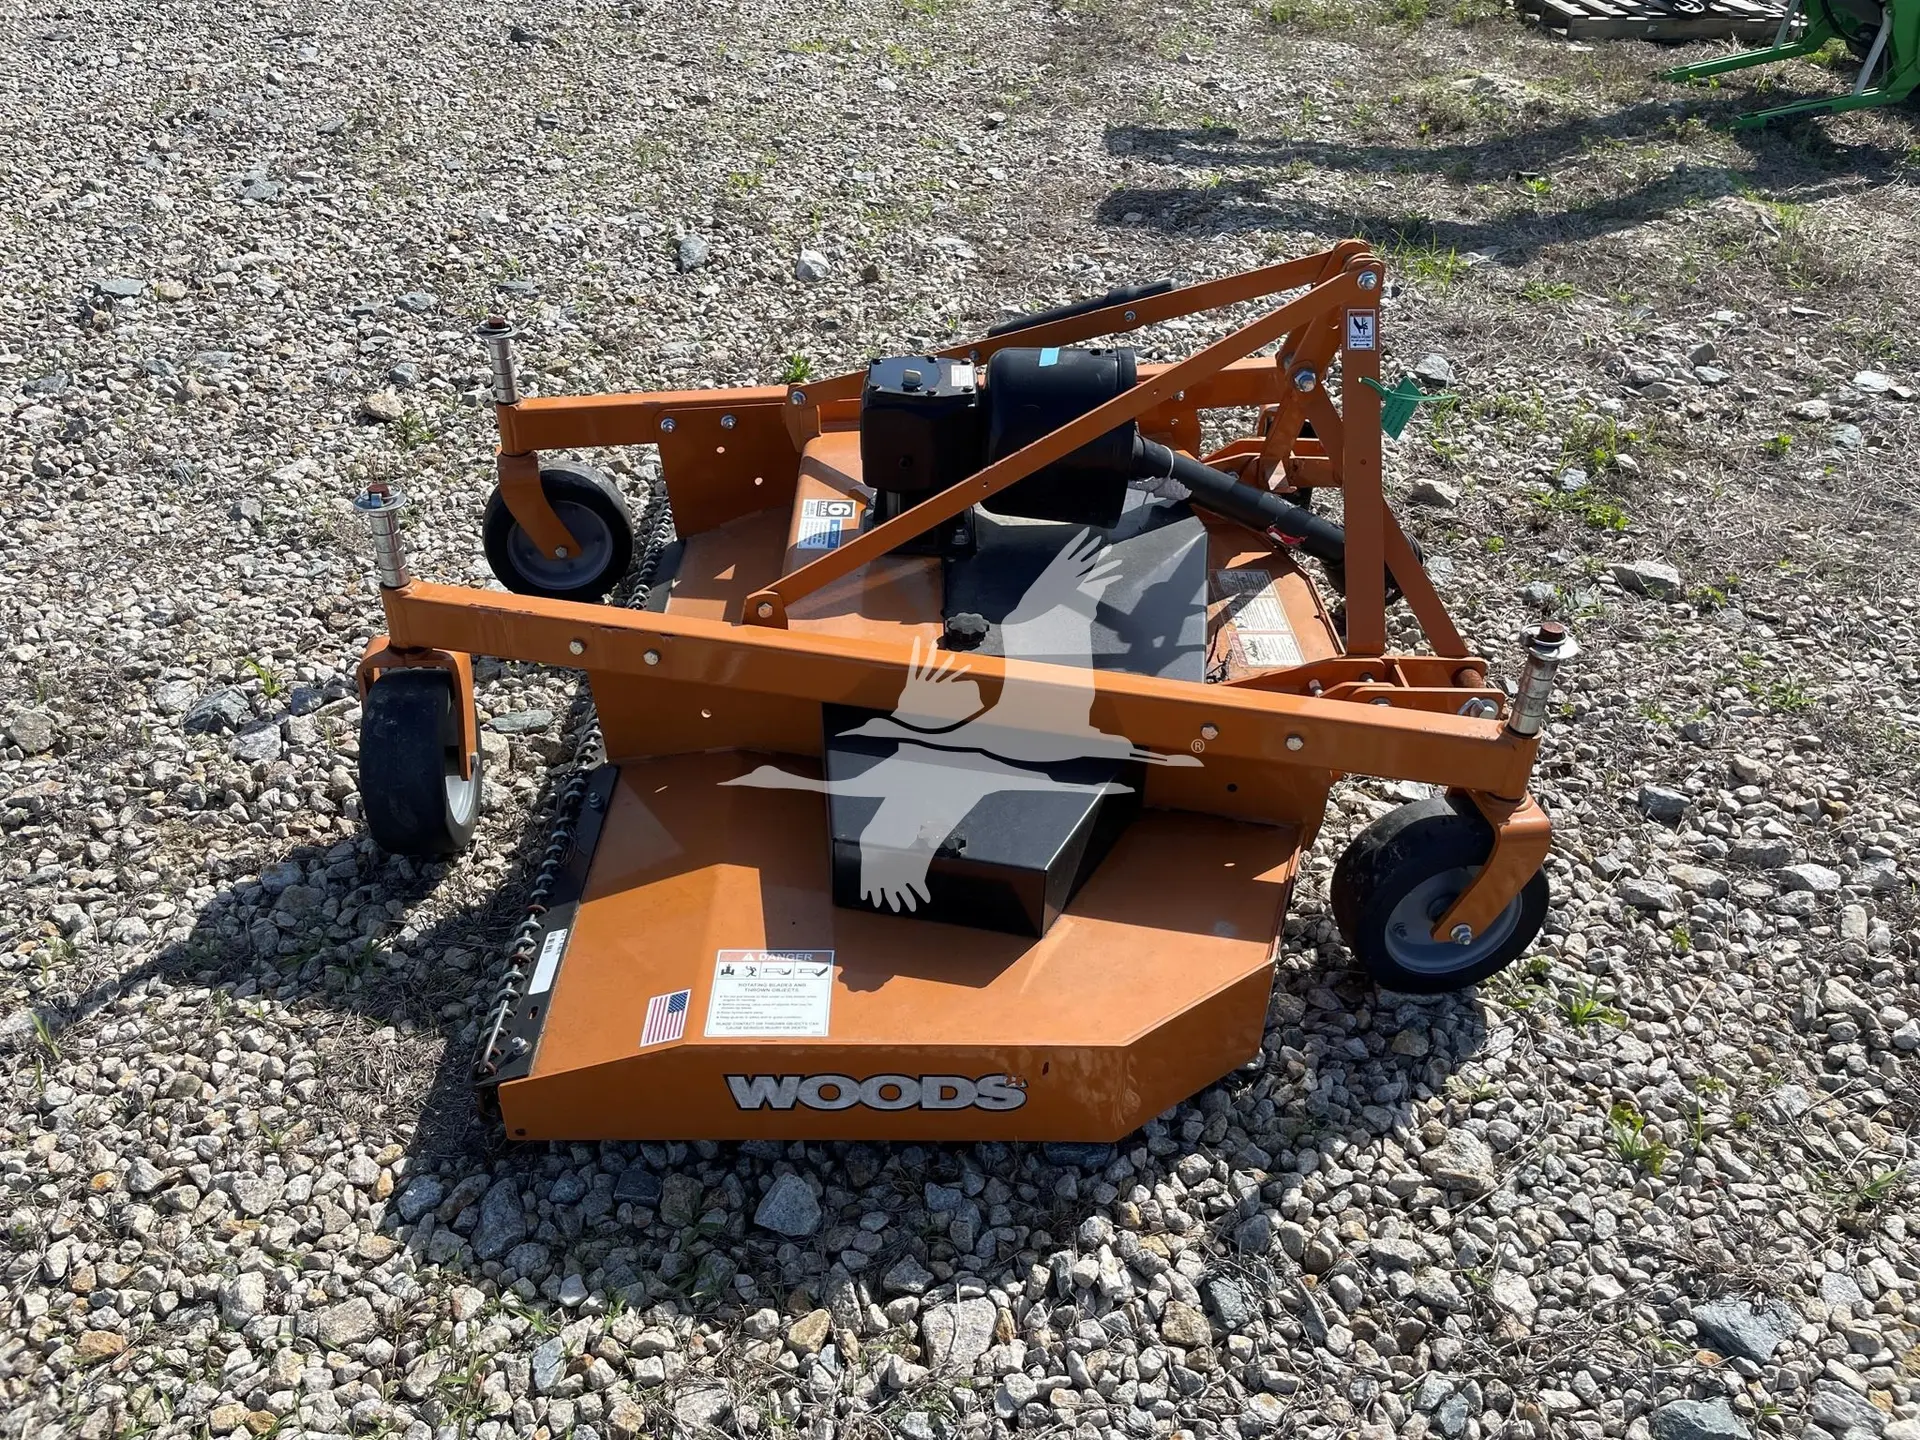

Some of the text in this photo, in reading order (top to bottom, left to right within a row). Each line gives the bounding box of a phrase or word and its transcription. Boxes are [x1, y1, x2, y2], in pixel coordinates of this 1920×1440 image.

[828, 502, 851, 516] 6
[758, 953, 813, 961] DANGER
[723, 1072, 1029, 1112] WOODS
